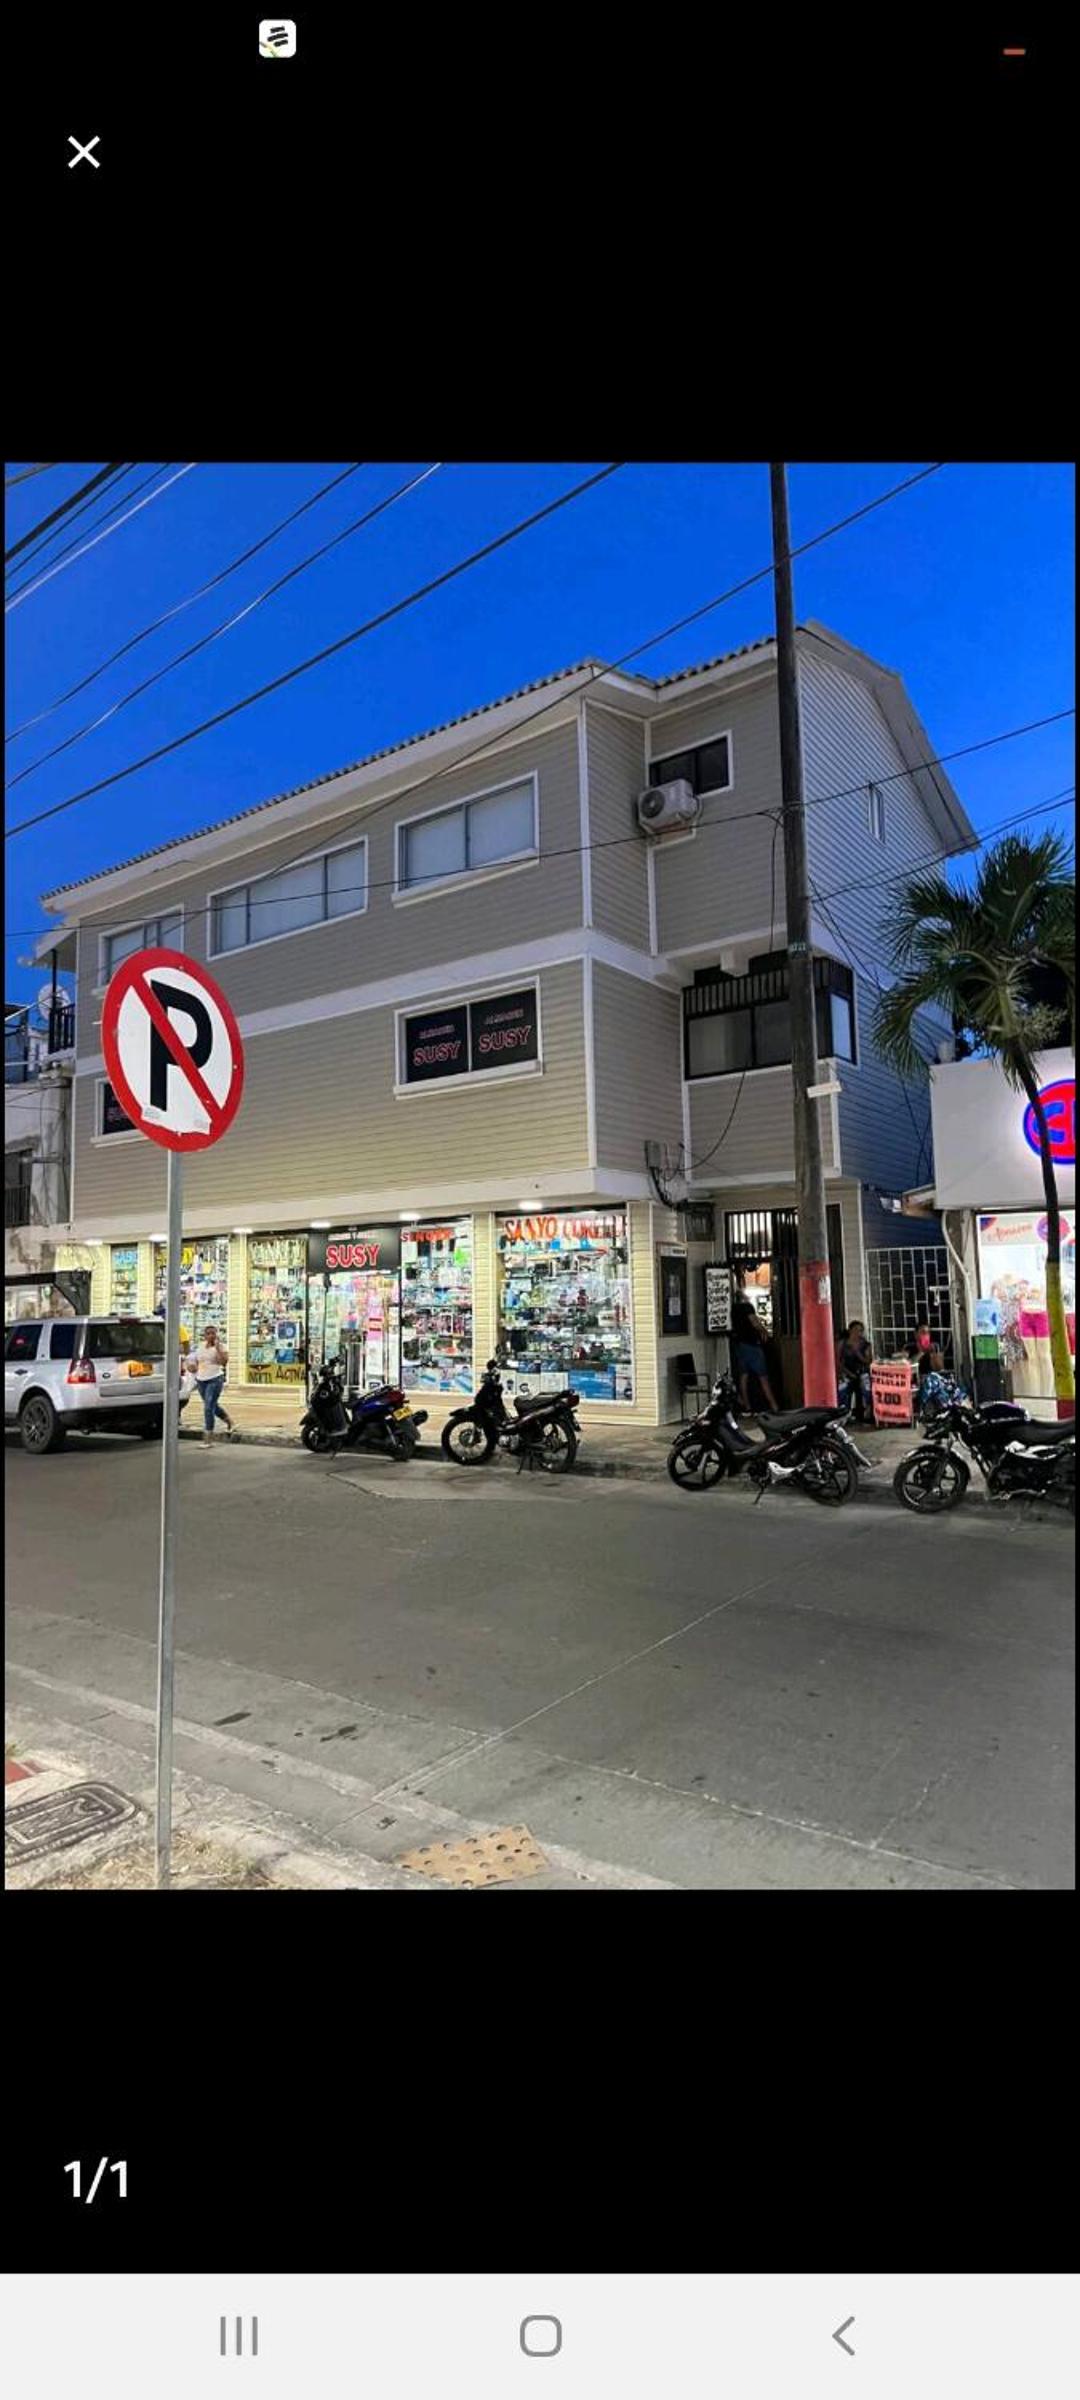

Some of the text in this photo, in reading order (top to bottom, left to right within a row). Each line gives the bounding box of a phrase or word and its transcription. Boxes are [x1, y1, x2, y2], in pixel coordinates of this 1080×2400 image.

[150, 979, 214, 1112] P
[480, 1024, 532, 1053] SUSY
[413, 1040, 461, 1067] SUSY
[505, 1216, 558, 1242] SANYO
[326, 1243, 380, 1268] SUSY
